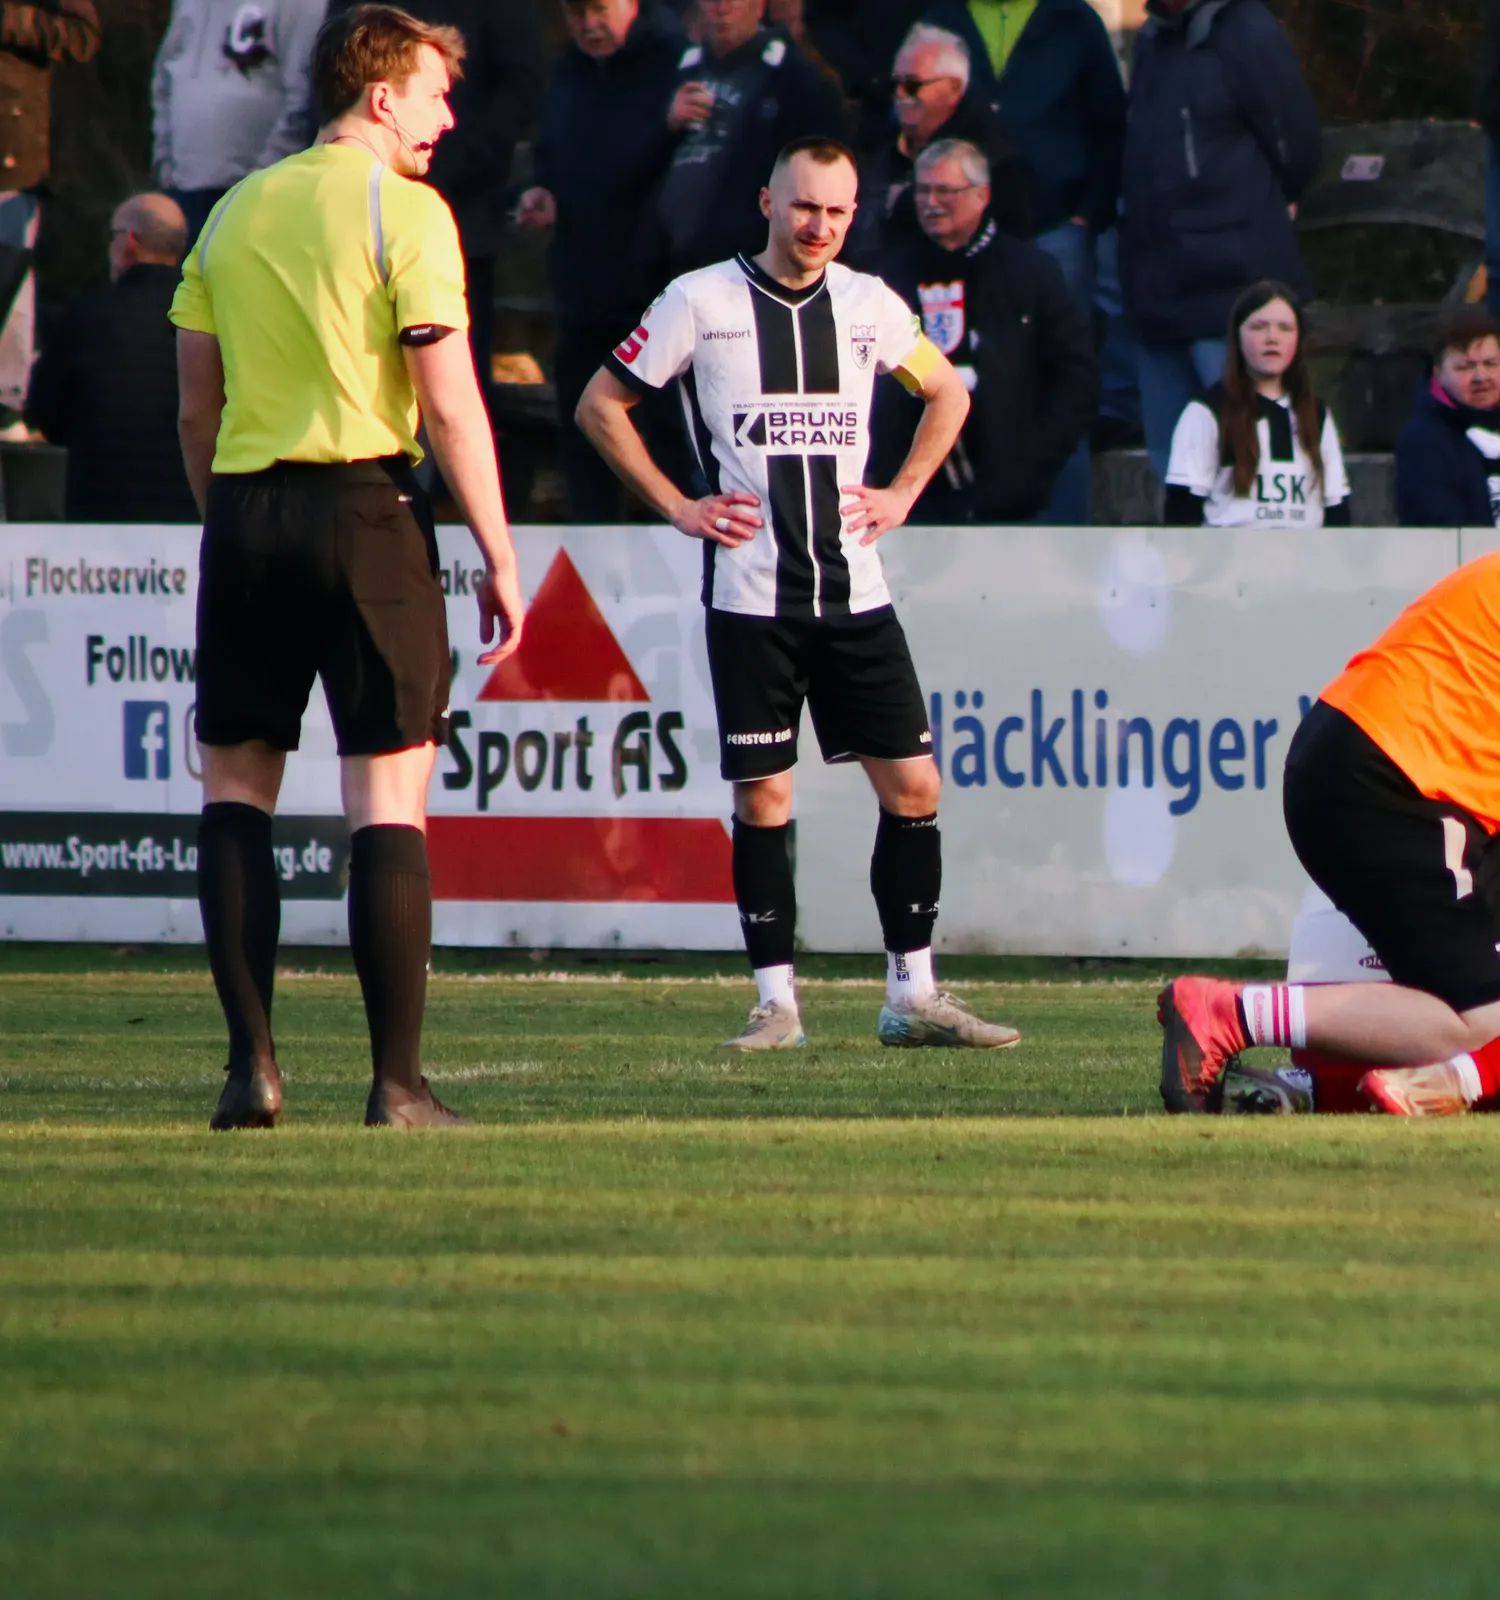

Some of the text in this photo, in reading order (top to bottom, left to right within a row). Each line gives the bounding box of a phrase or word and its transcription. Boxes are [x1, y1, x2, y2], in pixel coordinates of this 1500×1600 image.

[702, 330, 751, 341] uhlsport
[769, 412, 857, 427] BRUNS
[770, 430, 857, 446] KRANE
[1257, 473, 1306, 505] LSK
[26, 557, 187, 598] Flockservice
[87, 635, 197, 685] Follow
[726, 732, 773, 745] FENSTER
[442, 710, 688, 811] Sport AS
[1, 835, 332, 881] www.Sport-As-Larg.de
